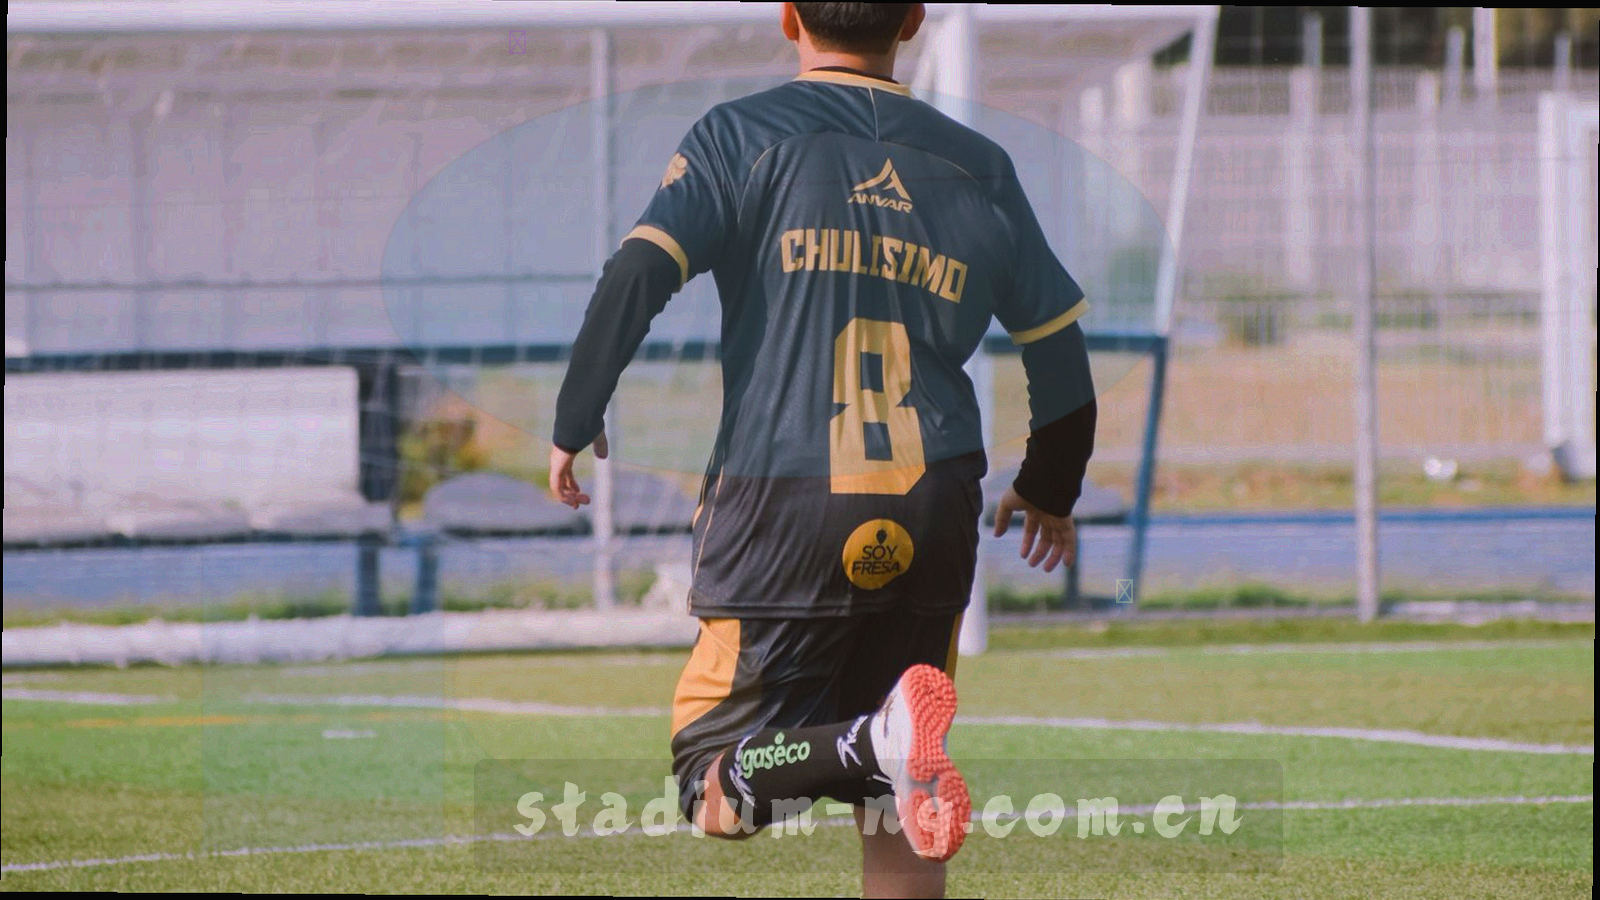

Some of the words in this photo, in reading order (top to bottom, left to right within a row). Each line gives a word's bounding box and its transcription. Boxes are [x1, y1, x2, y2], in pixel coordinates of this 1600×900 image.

[848, 192, 913, 214] ANVAR
[781, 229, 968, 304] CHULISIMO
[829, 317, 926, 495] 8
[862, 545, 898, 560] SOY
[851, 560, 901, 576] FRESA
